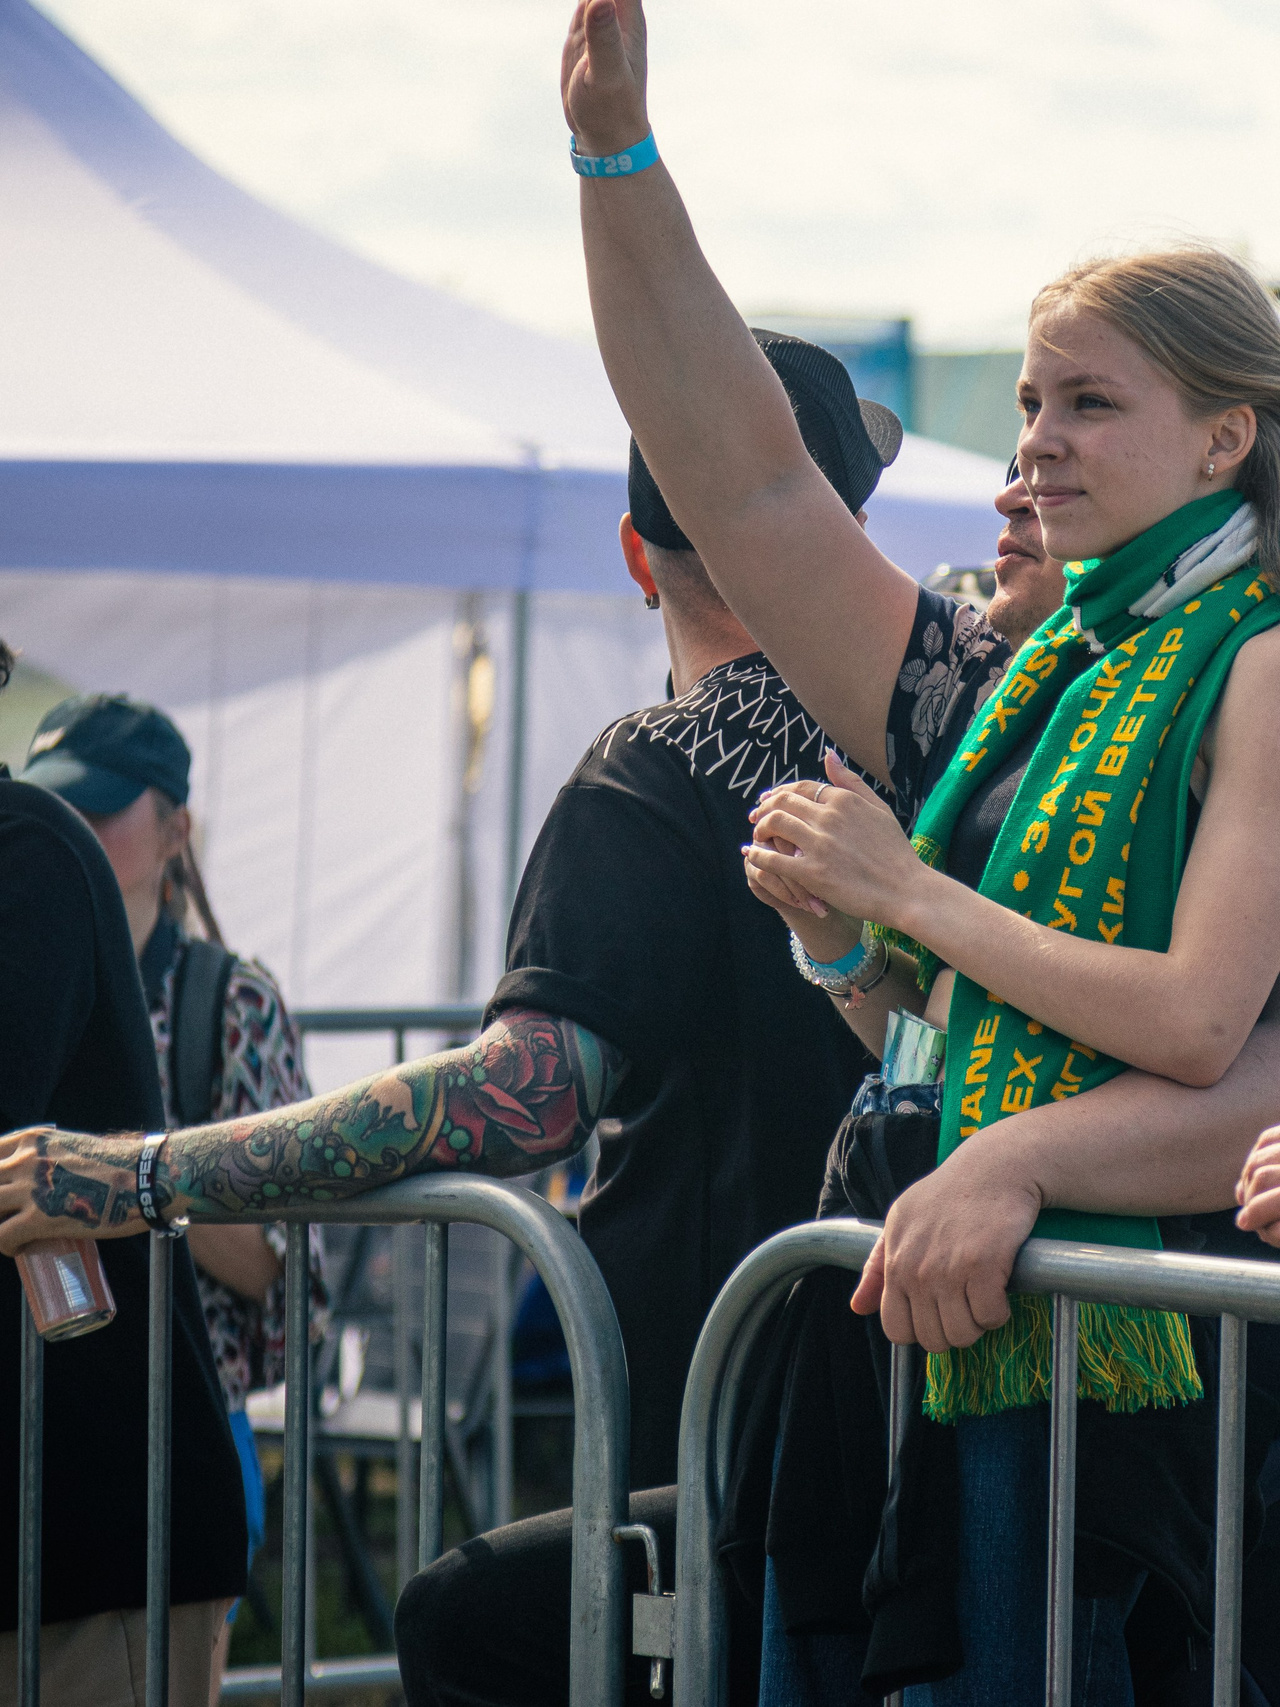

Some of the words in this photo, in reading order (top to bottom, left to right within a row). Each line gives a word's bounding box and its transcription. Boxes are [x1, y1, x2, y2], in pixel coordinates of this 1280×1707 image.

[603, 154, 633, 174] 29
[1020, 627, 1150, 854] ЗАТОЧКА
[1095, 627, 1184, 776] ВЕТЕР
[140, 1192, 157, 1218] 29
